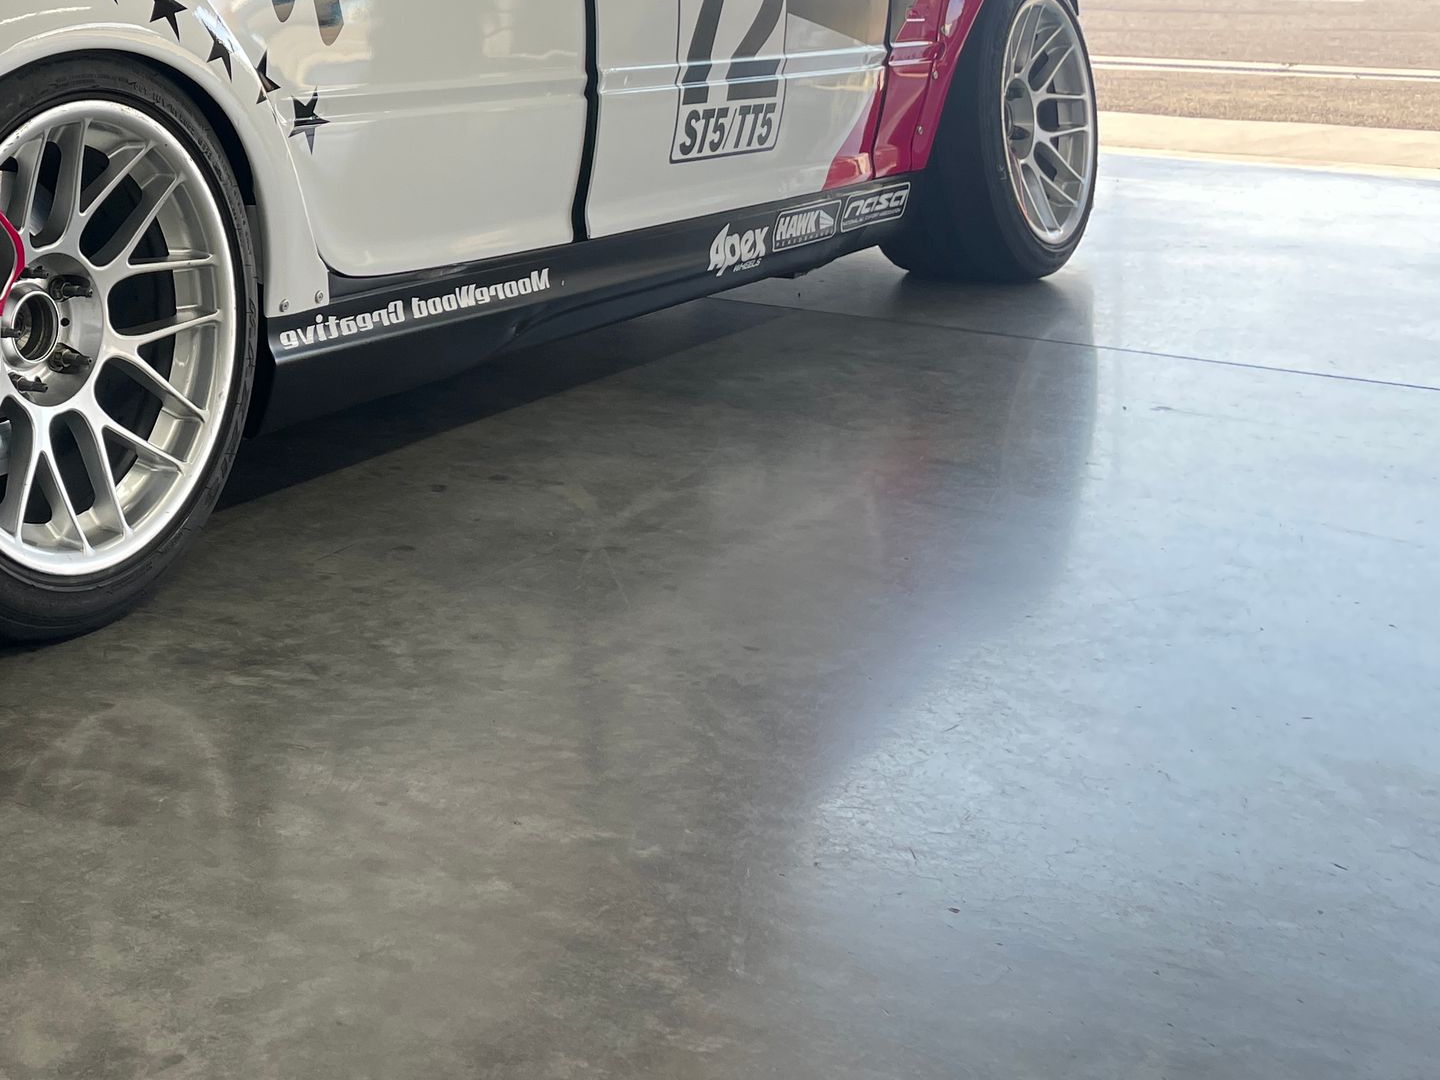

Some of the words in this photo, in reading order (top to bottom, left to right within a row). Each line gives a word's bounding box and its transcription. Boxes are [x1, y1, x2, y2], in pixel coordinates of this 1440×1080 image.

[679, 103, 776, 156] ST5/TT5
[776, 210, 820, 241] HAWK
[707, 223, 770, 277] Apex
[733, 258, 762, 273] WHEELS
